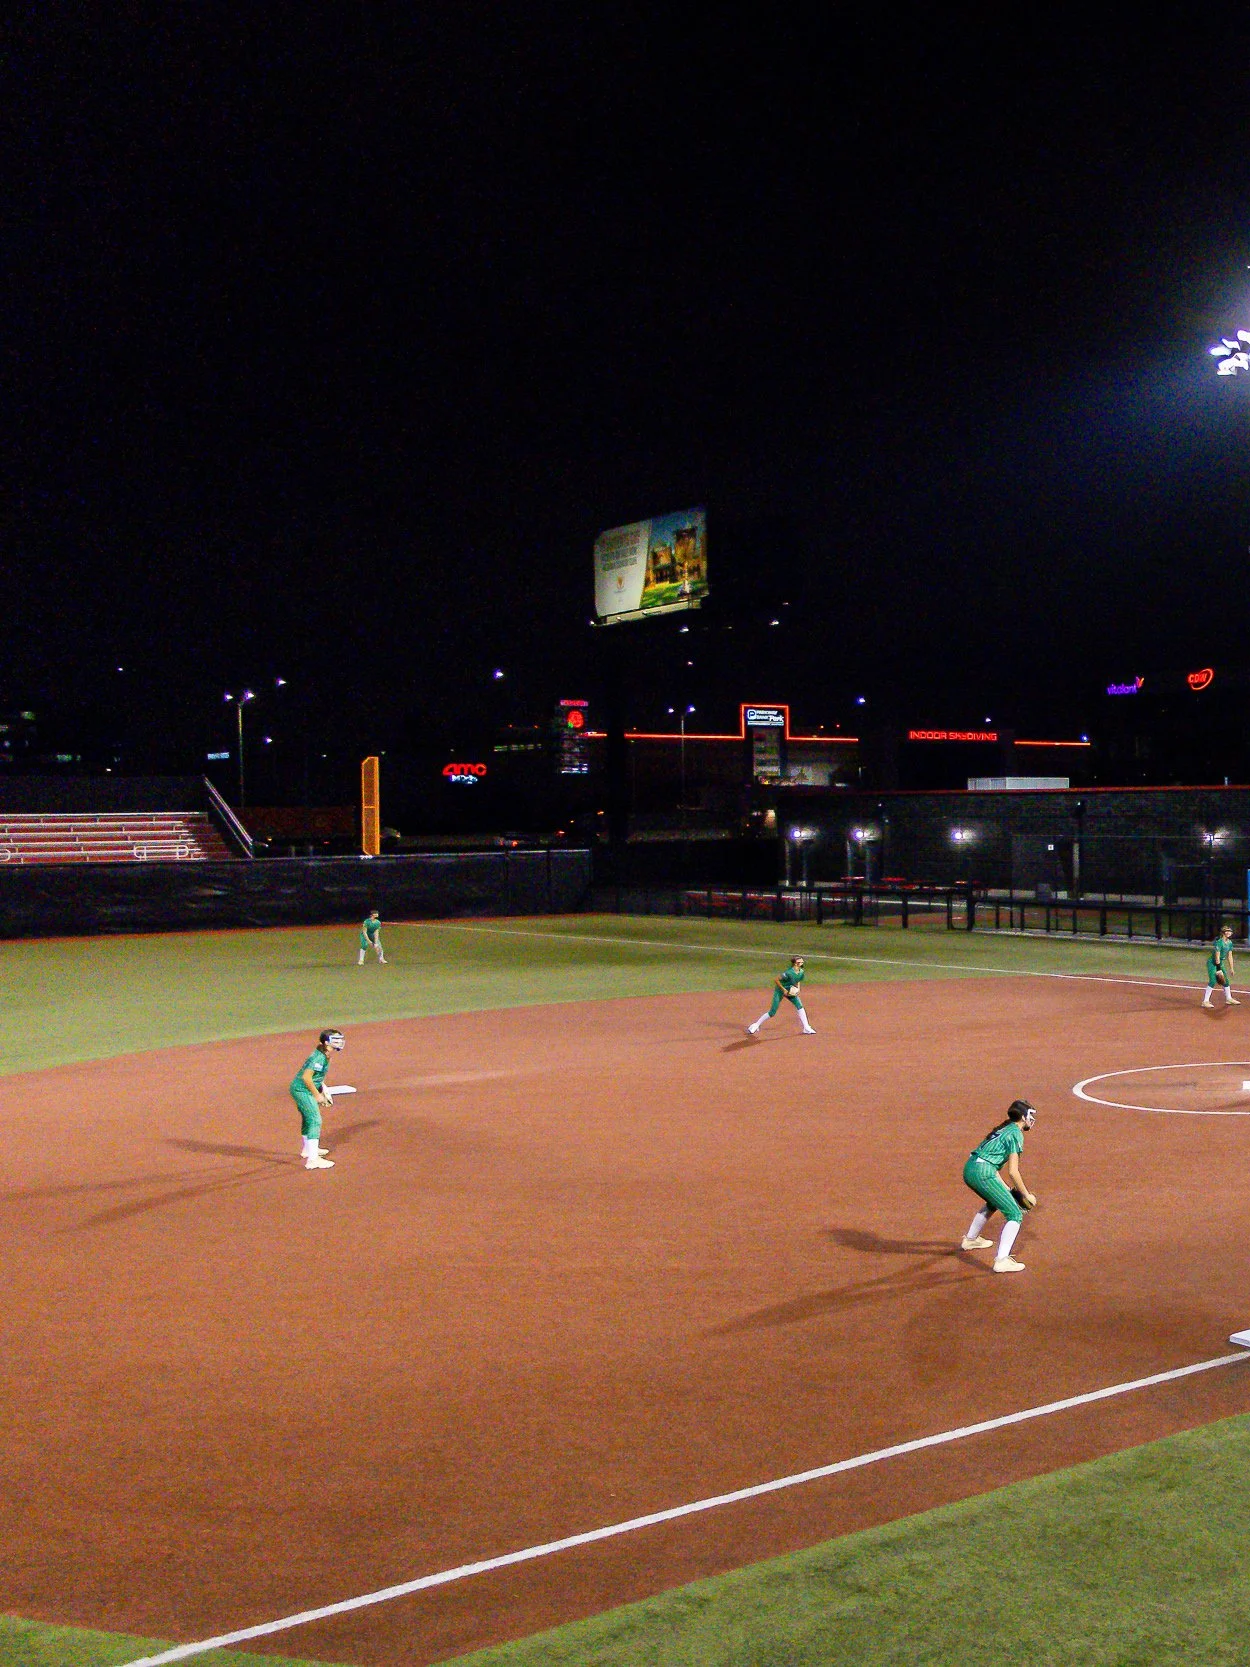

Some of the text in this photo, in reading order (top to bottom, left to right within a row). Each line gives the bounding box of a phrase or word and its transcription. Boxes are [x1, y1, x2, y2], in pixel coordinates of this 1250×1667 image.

[1107, 683, 1138, 695] vitalant
[769, 714, 784, 723] Park
[909, 731, 997, 741] INDOOR SKYDIVING
